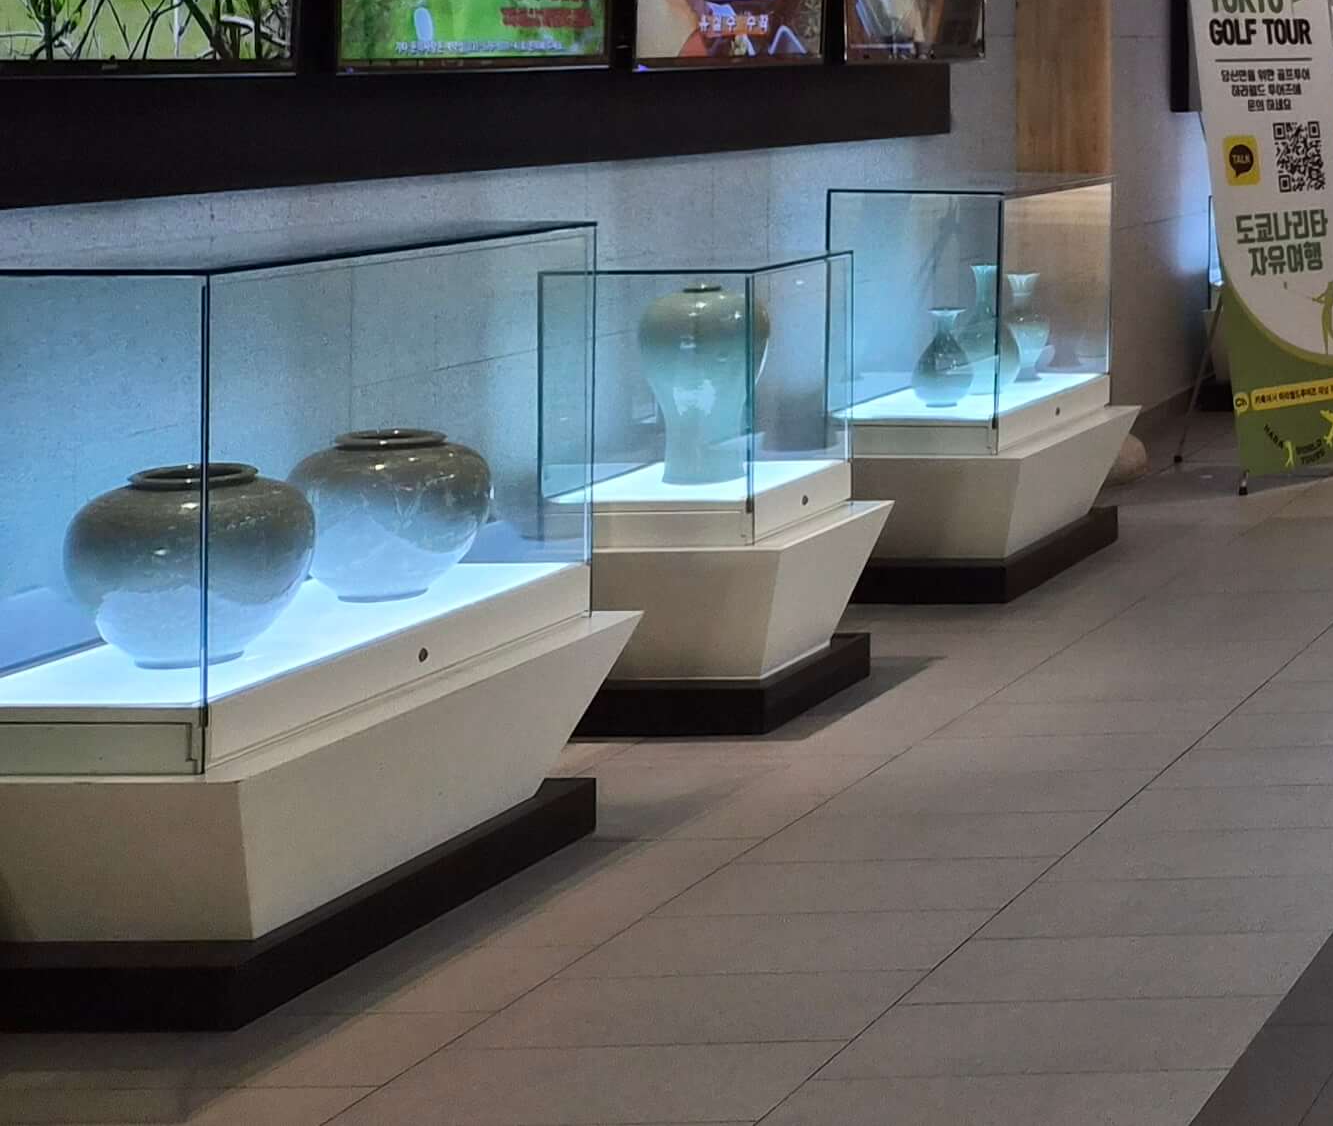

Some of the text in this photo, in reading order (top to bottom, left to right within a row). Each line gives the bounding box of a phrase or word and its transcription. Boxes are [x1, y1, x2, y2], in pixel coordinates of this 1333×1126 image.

[1208, 17, 1313, 45] GOLF TOUR
[1231, 154, 1251, 164] TALK
[1247, 240, 1324, 276] 자유여행
